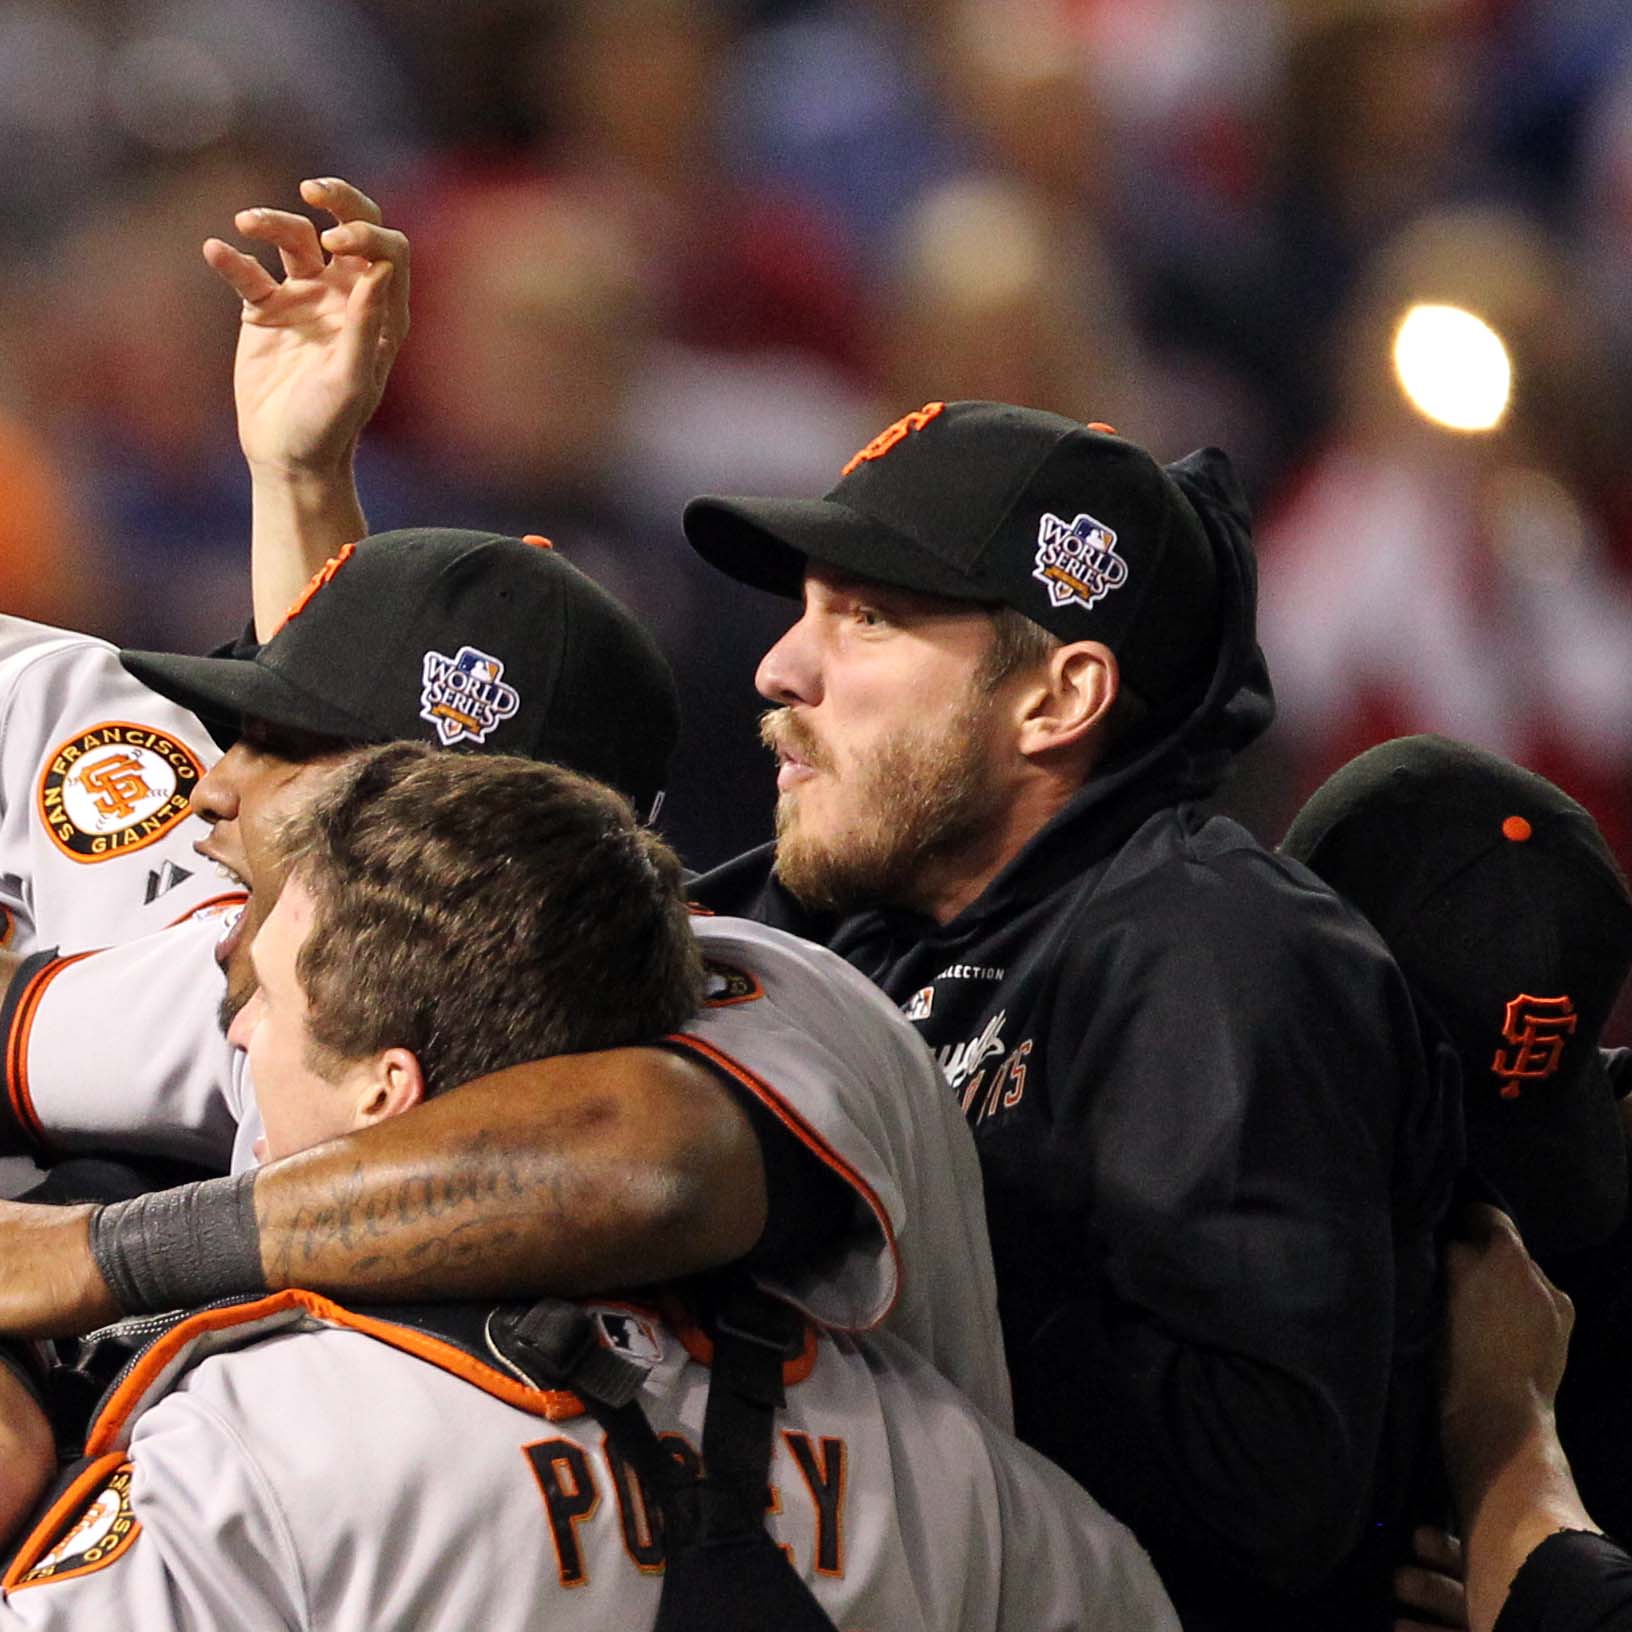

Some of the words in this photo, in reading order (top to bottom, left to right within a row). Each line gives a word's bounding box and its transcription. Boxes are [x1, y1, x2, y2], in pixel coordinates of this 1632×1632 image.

[1042, 543, 1104, 593] SERIES
[1045, 520, 1124, 582] WORLD
[428, 681, 494, 725] SERIES
[429, 656, 515, 713] WORLD
[52, 728, 195, 779] FRANCISCO
[44, 786, 75, 842] SAN
[91, 794, 188, 854] GIANTS
[521, 1428, 849, 1589] POY
